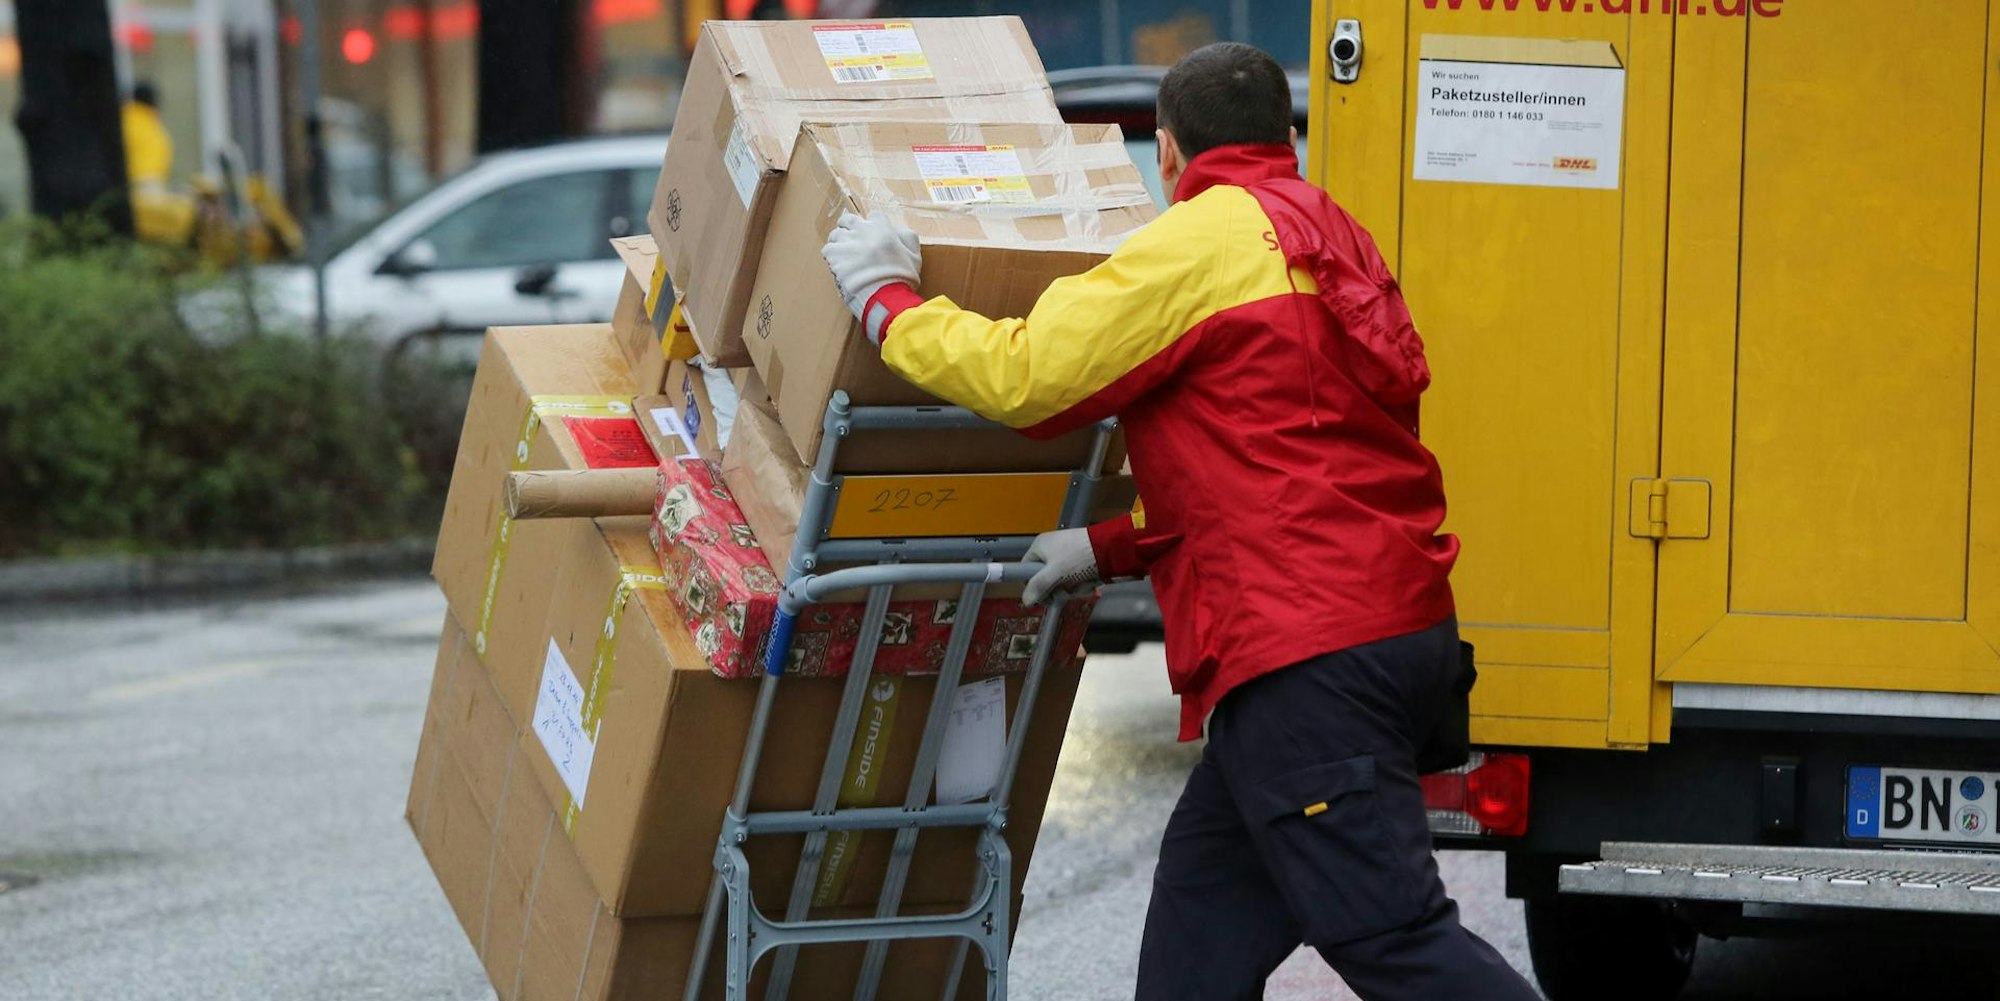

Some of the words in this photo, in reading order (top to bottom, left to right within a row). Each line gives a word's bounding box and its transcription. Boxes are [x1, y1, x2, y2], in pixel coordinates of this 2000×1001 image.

[1431, 71, 1446, 79] Wir
[1448, 72, 1479, 81] suchen
[1431, 87, 1586, 107] Paketzusteller/innen
[1430, 108, 1469, 118] Telefon:
[1472, 110, 1495, 119] 0180
[1507, 111, 1524, 120] 146
[1526, 112, 1544, 121] 033
[1559, 158, 1592, 169] DHL
[868, 488, 959, 513] 2207
[855, 706, 884, 789] FINSIDE
[1856, 809, 1869, 825] D
[1884, 775, 1952, 831] BN
